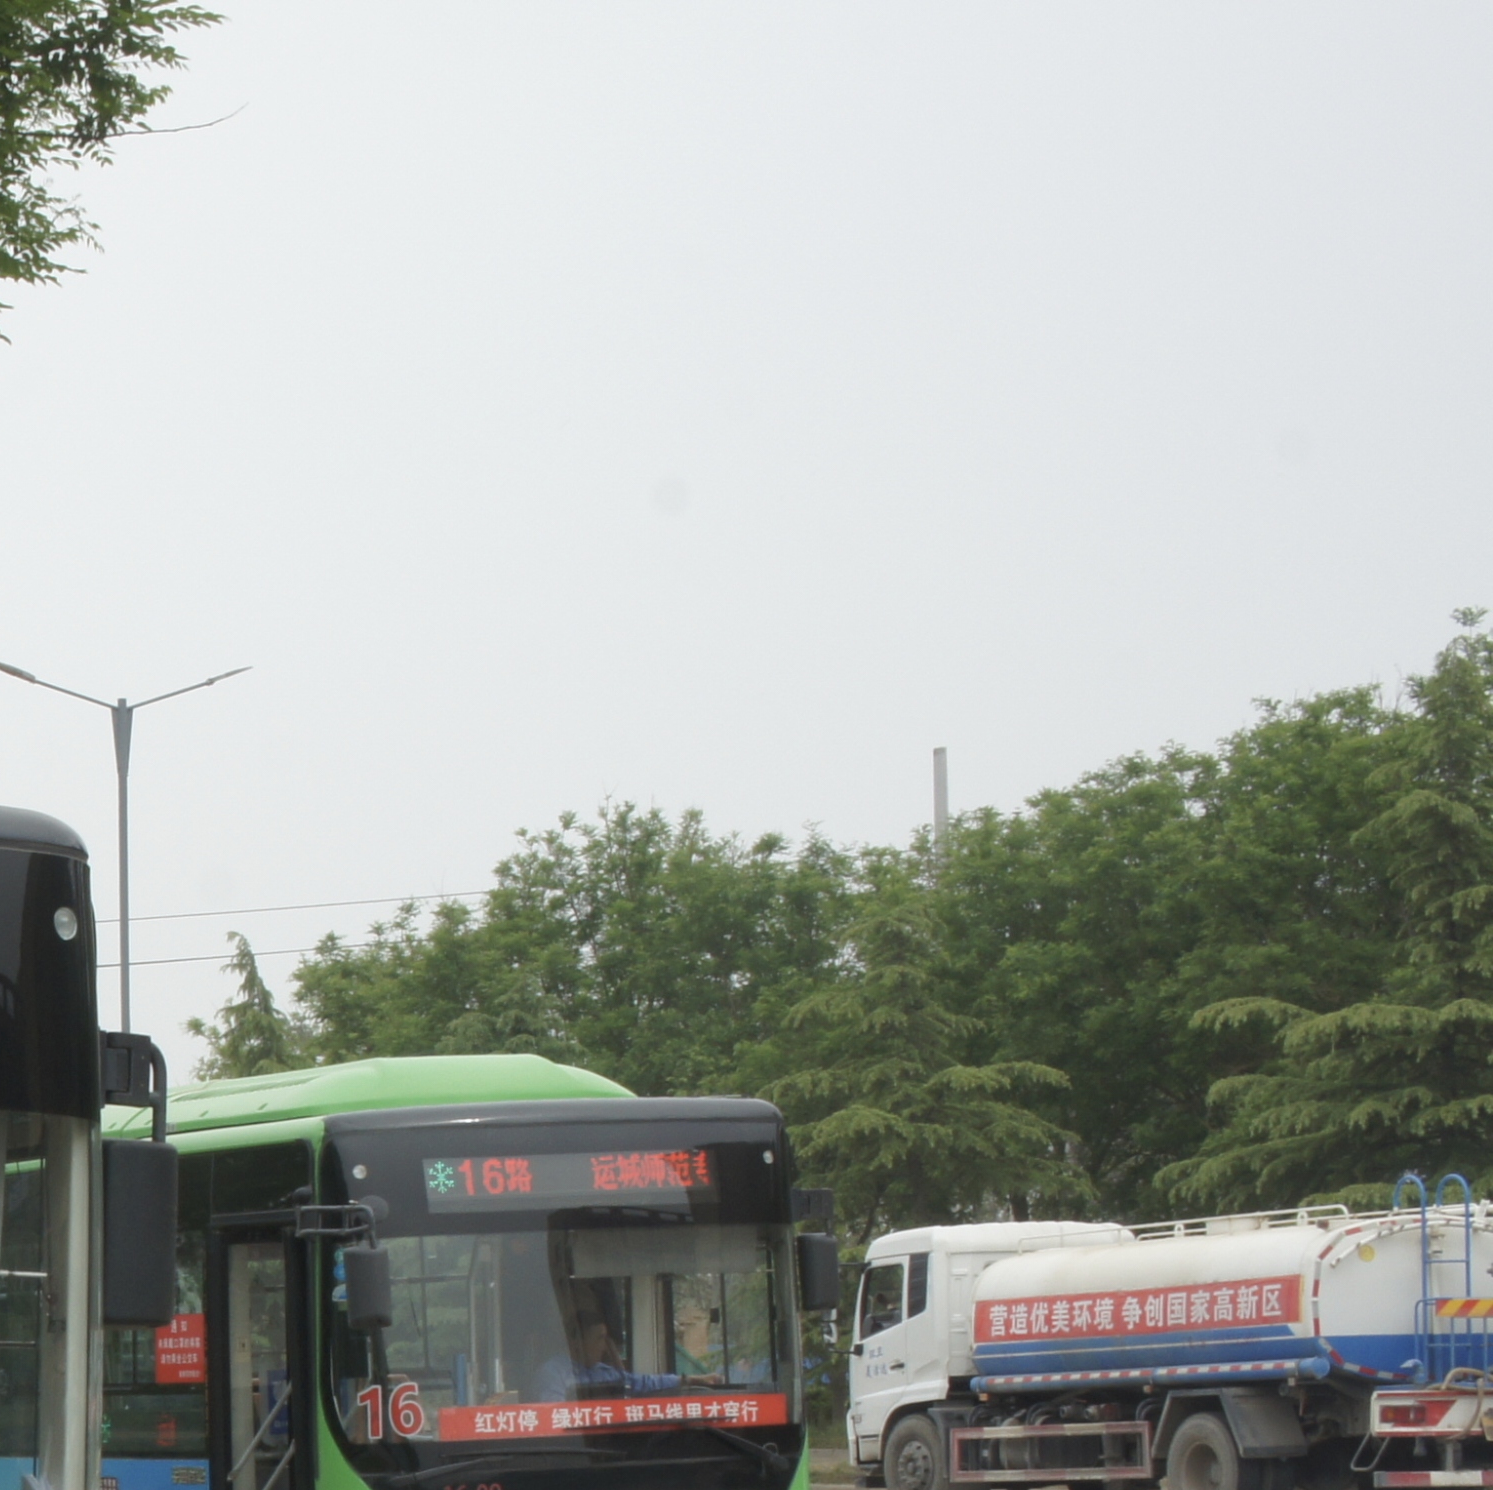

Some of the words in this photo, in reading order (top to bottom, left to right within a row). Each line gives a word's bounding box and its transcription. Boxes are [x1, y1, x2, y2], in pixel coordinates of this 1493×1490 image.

[458, 1156, 532, 1196] 16路
[989, 1297, 1115, 1337] 营造优美环境
[1122, 1284, 1282, 1330] 争创国家高新区
[357, 1382, 425, 1440] 16
[475, 1407, 539, 1434] 红灯停
[551, 1402, 614, 1430] 绿灯行
